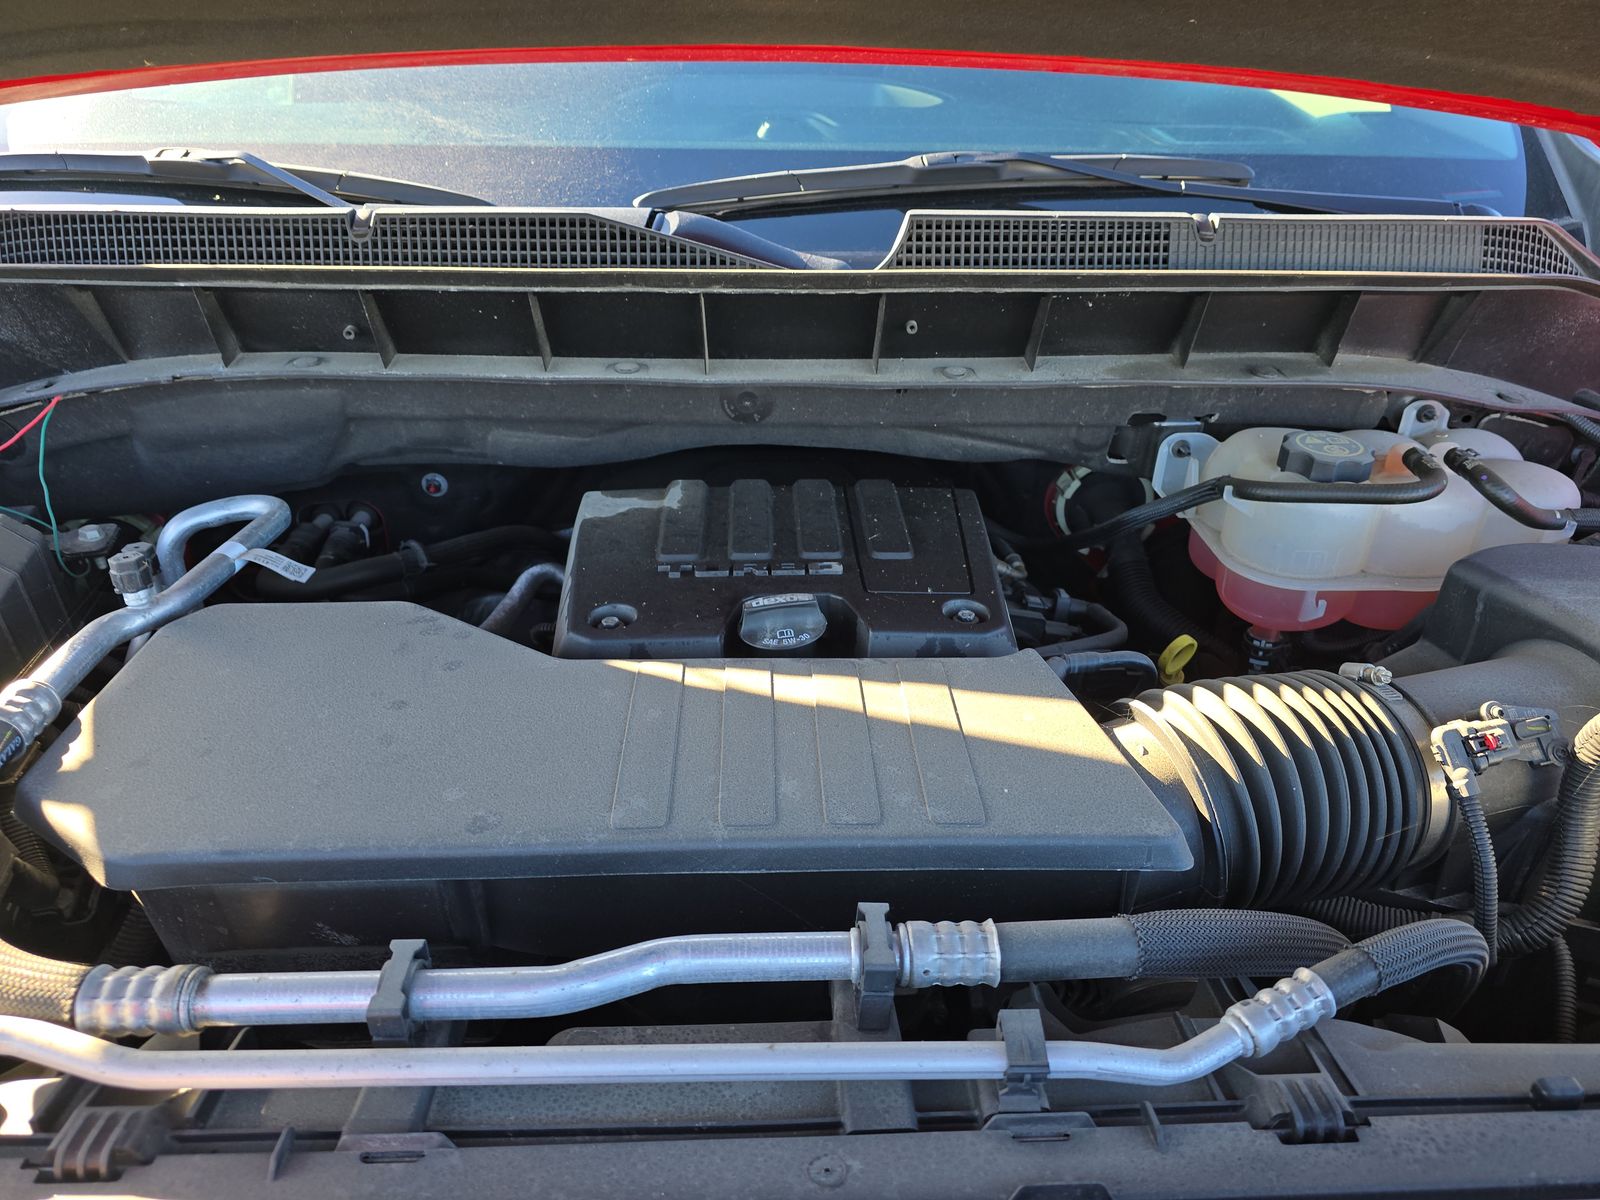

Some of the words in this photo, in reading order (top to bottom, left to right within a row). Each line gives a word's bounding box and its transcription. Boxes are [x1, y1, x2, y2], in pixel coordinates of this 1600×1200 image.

[657, 561, 844, 579] TURBO
[751, 594, 813, 608] dexos
[762, 638, 779, 646] SAE
[782, 632, 811, 646] 5W-30
